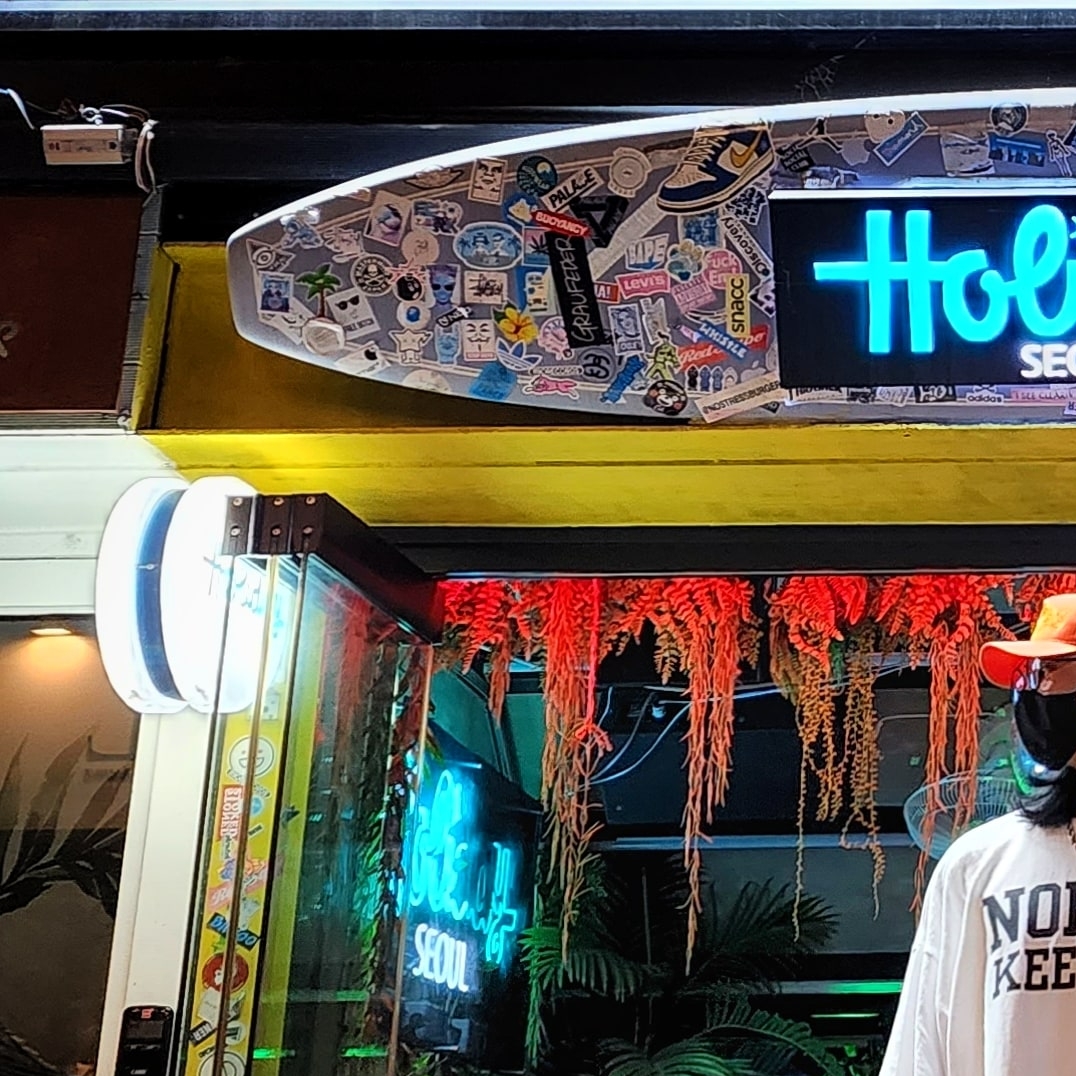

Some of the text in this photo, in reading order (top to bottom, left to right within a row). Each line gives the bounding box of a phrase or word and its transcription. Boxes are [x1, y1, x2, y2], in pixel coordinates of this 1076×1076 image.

[721, 217, 770, 276] Discovery
[731, 278, 745, 333] snacc
[967, 393, 1002, 403] adidas
[412, 922, 469, 993] SEOUL
